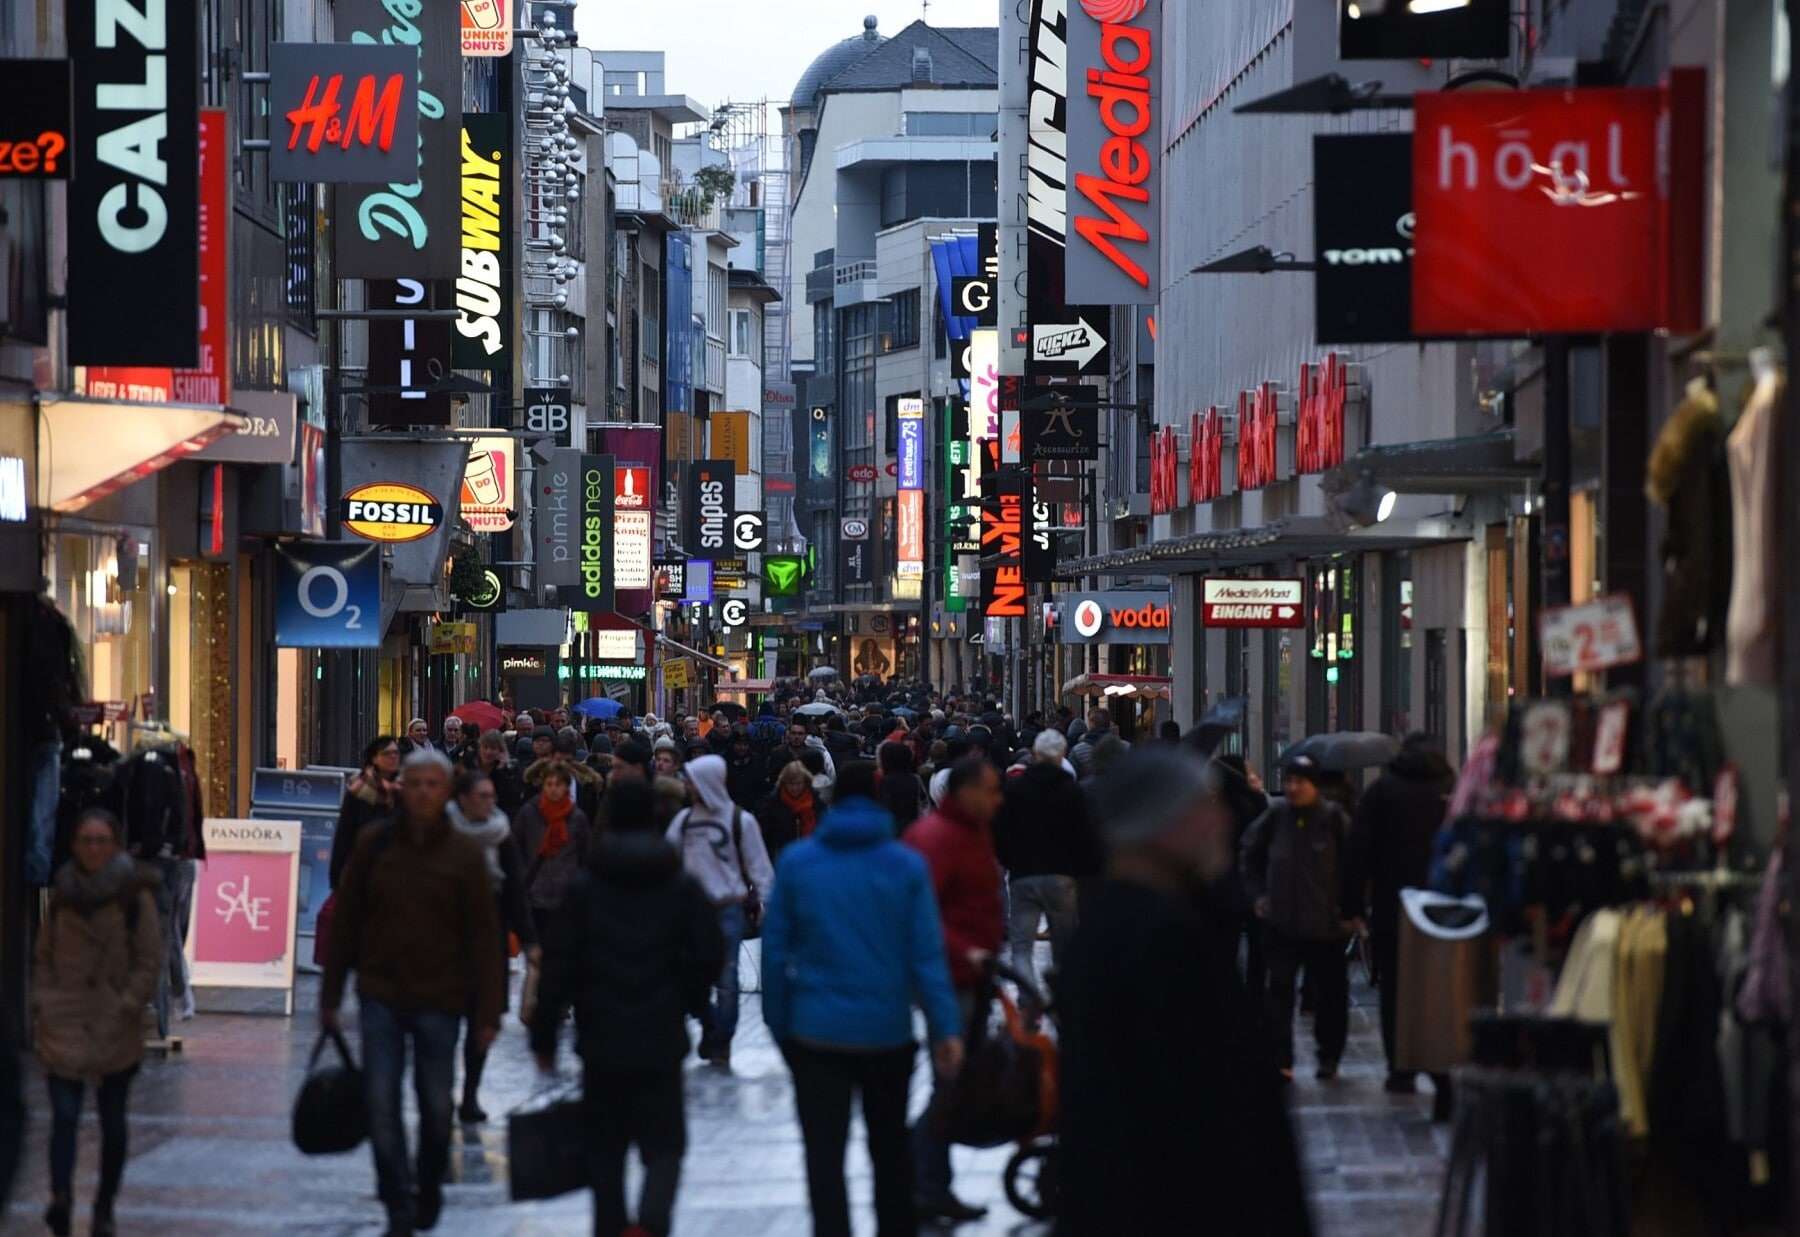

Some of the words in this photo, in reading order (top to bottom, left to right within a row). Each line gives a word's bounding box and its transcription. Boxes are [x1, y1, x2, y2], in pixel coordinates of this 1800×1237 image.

[463, 30, 508, 40] UNKIN'
[463, 41, 505, 50] ONUTS
[287, 73, 404, 154] H&M
[1074, 22, 1152, 289] Media
[584, 469, 600, 512] neo
[349, 501, 434, 524] FOSSIL
[551, 471, 568, 563] pimkie
[699, 481, 728, 548] snipes
[581, 517, 600, 597] adidas
[1212, 604, 1272, 619] EINGANG
[503, 657, 540, 669] pimkie
